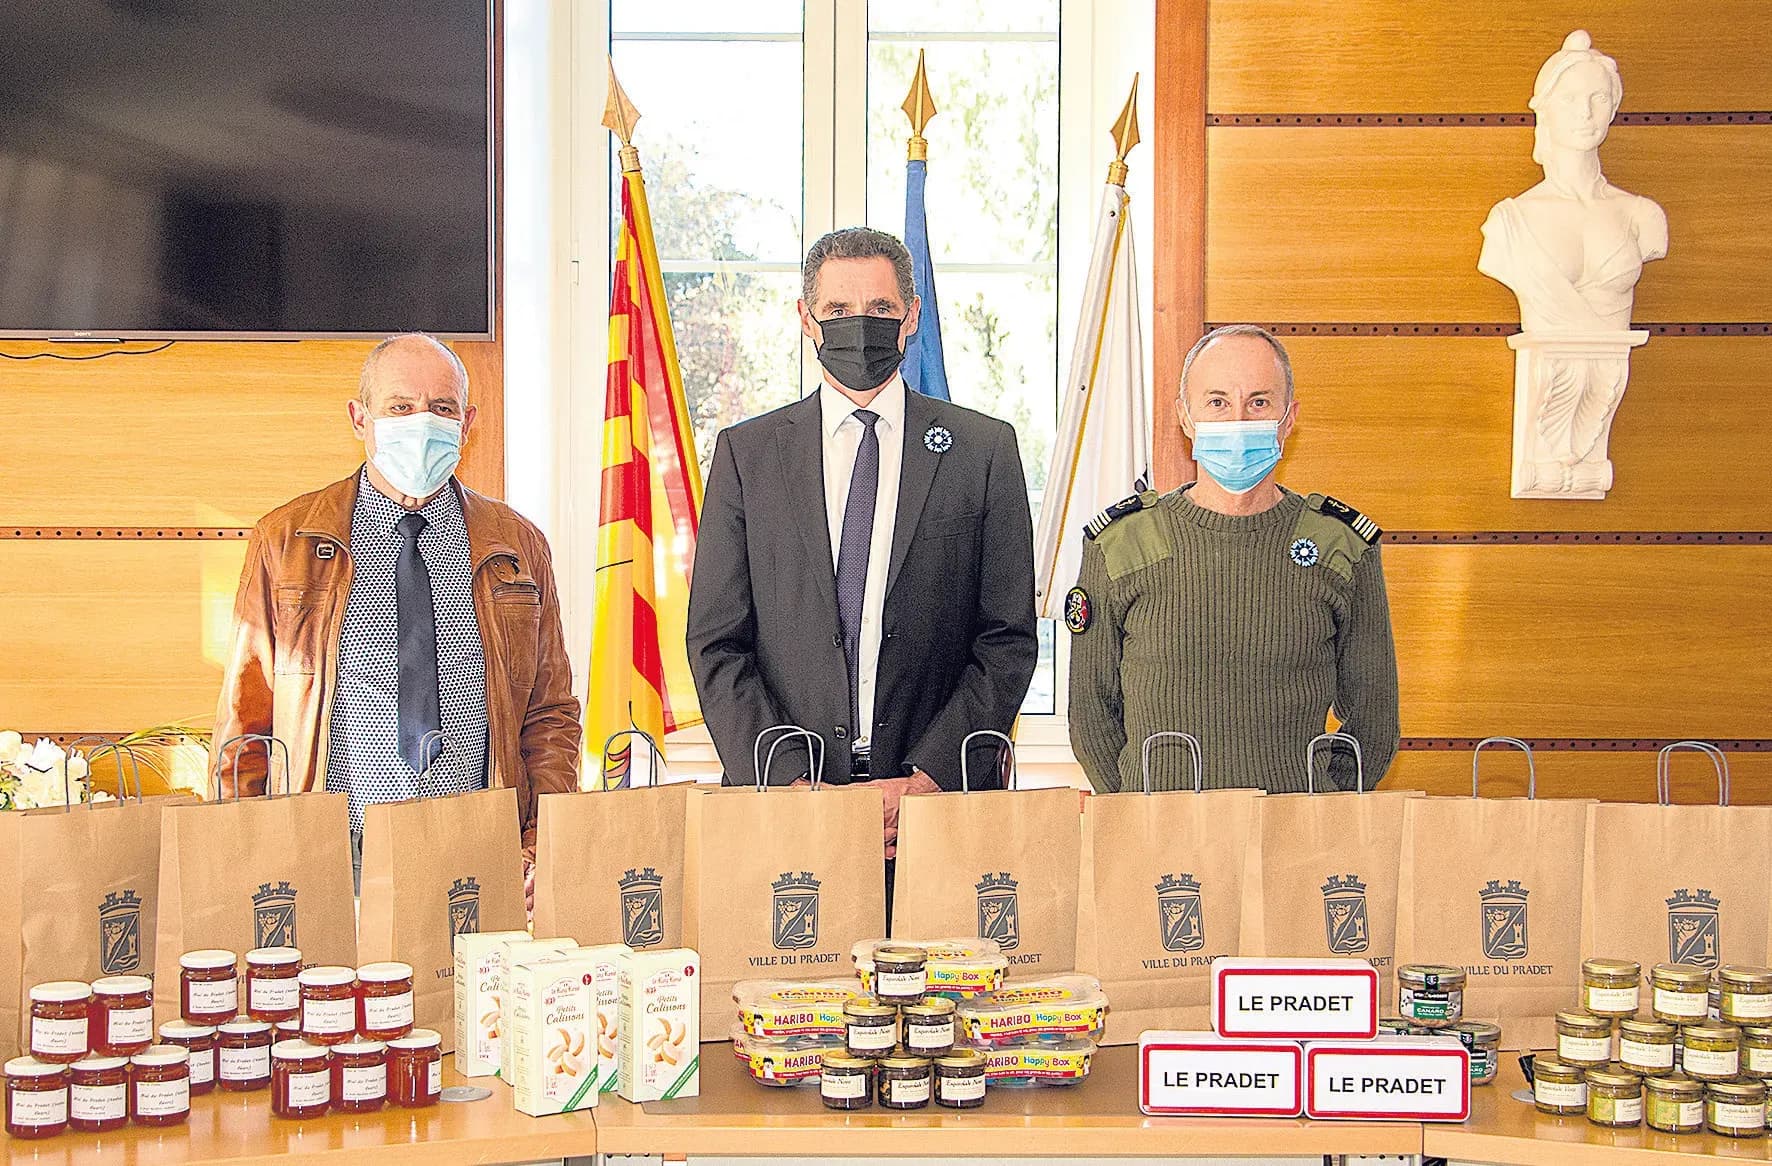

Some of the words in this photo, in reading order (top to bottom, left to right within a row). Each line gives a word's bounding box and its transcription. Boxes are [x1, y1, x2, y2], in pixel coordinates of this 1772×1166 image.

[748, 956, 778, 966] VILLE
[781, 955, 796, 965] DU
[800, 953, 841, 964] PRADET
[1142, 959, 1170, 969] VILLE
[1172, 957, 1187, 967] DU
[1190, 955, 1228, 966] PRAD
[1367, 957, 1392, 967] ADET
[934, 970, 959, 983] Happy
[962, 972, 979, 981] Box
[1493, 965, 1509, 975] DU
[1512, 965, 1553, 976] PRADET
[1239, 995, 1264, 1011] LE
[1270, 995, 1354, 1011] PRADET
[774, 1013, 814, 1026] HARIBO
[819, 1013, 842, 1024] Happ
[990, 1014, 1031, 1028] HARIBO
[1036, 1013, 1061, 1024] Happy
[1064, 1013, 1082, 1022] Box
[784, 1054, 822, 1068] HARIBO
[984, 1056, 1018, 1068] ARIBO
[1023, 1056, 1049, 1067] Happy
[1052, 1057, 1070, 1066] Box
[1164, 1071, 1188, 1087] LE
[1195, 1072, 1279, 1089] PRADET
[1329, 1076, 1354, 1093] LE
[1361, 1077, 1446, 1095] PRADET
